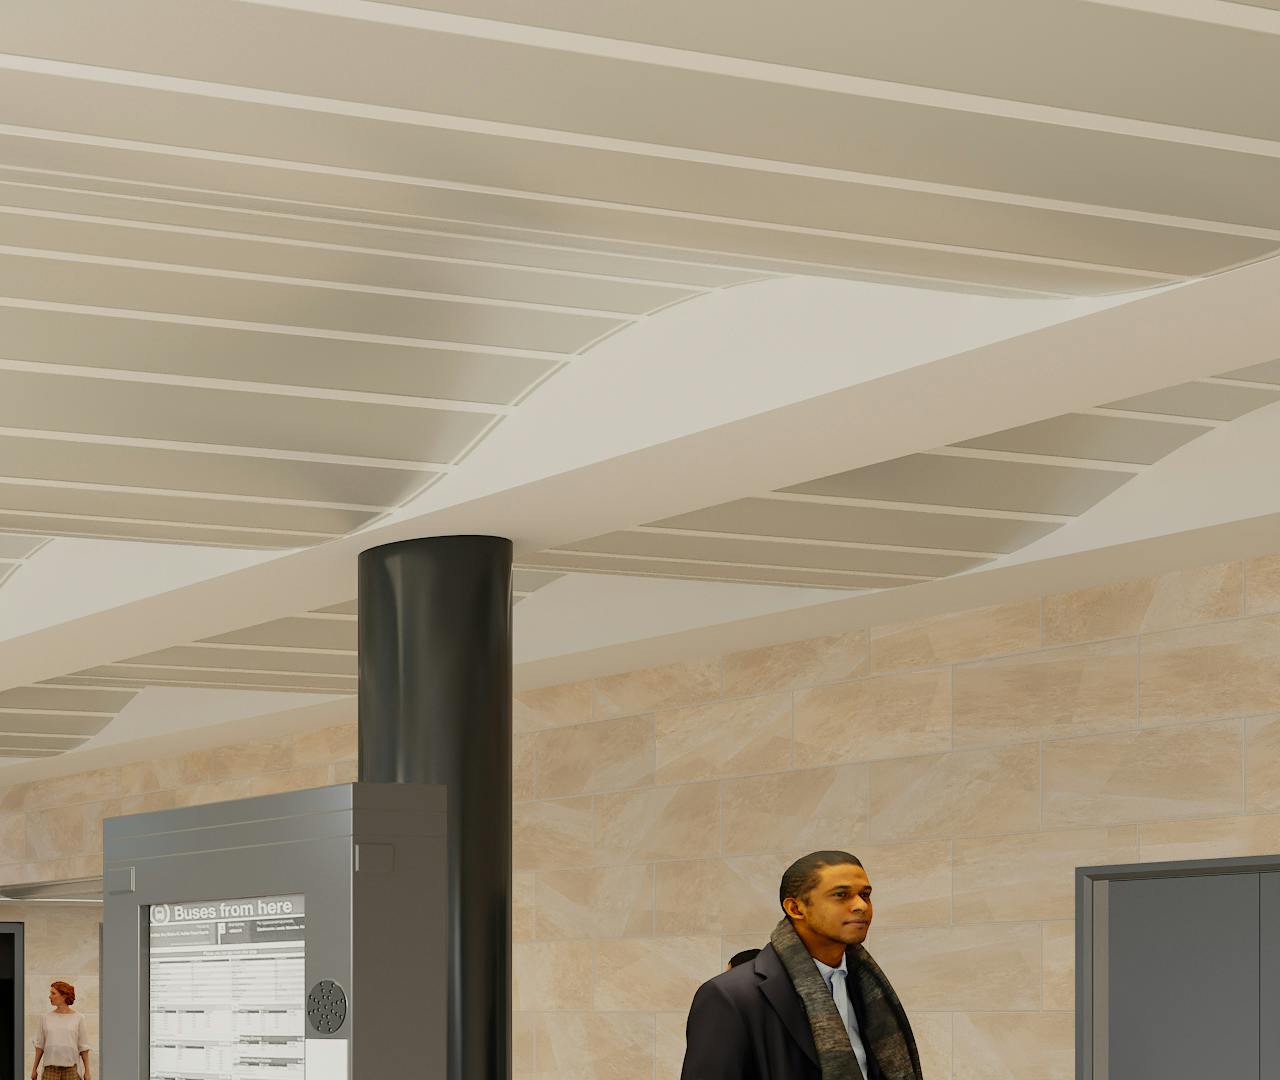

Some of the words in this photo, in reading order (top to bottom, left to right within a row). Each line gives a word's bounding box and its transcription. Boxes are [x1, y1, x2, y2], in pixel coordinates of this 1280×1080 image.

[174, 906, 216, 920] Buses
[220, 903, 254, 917] from
[258, 900, 292, 914] here
